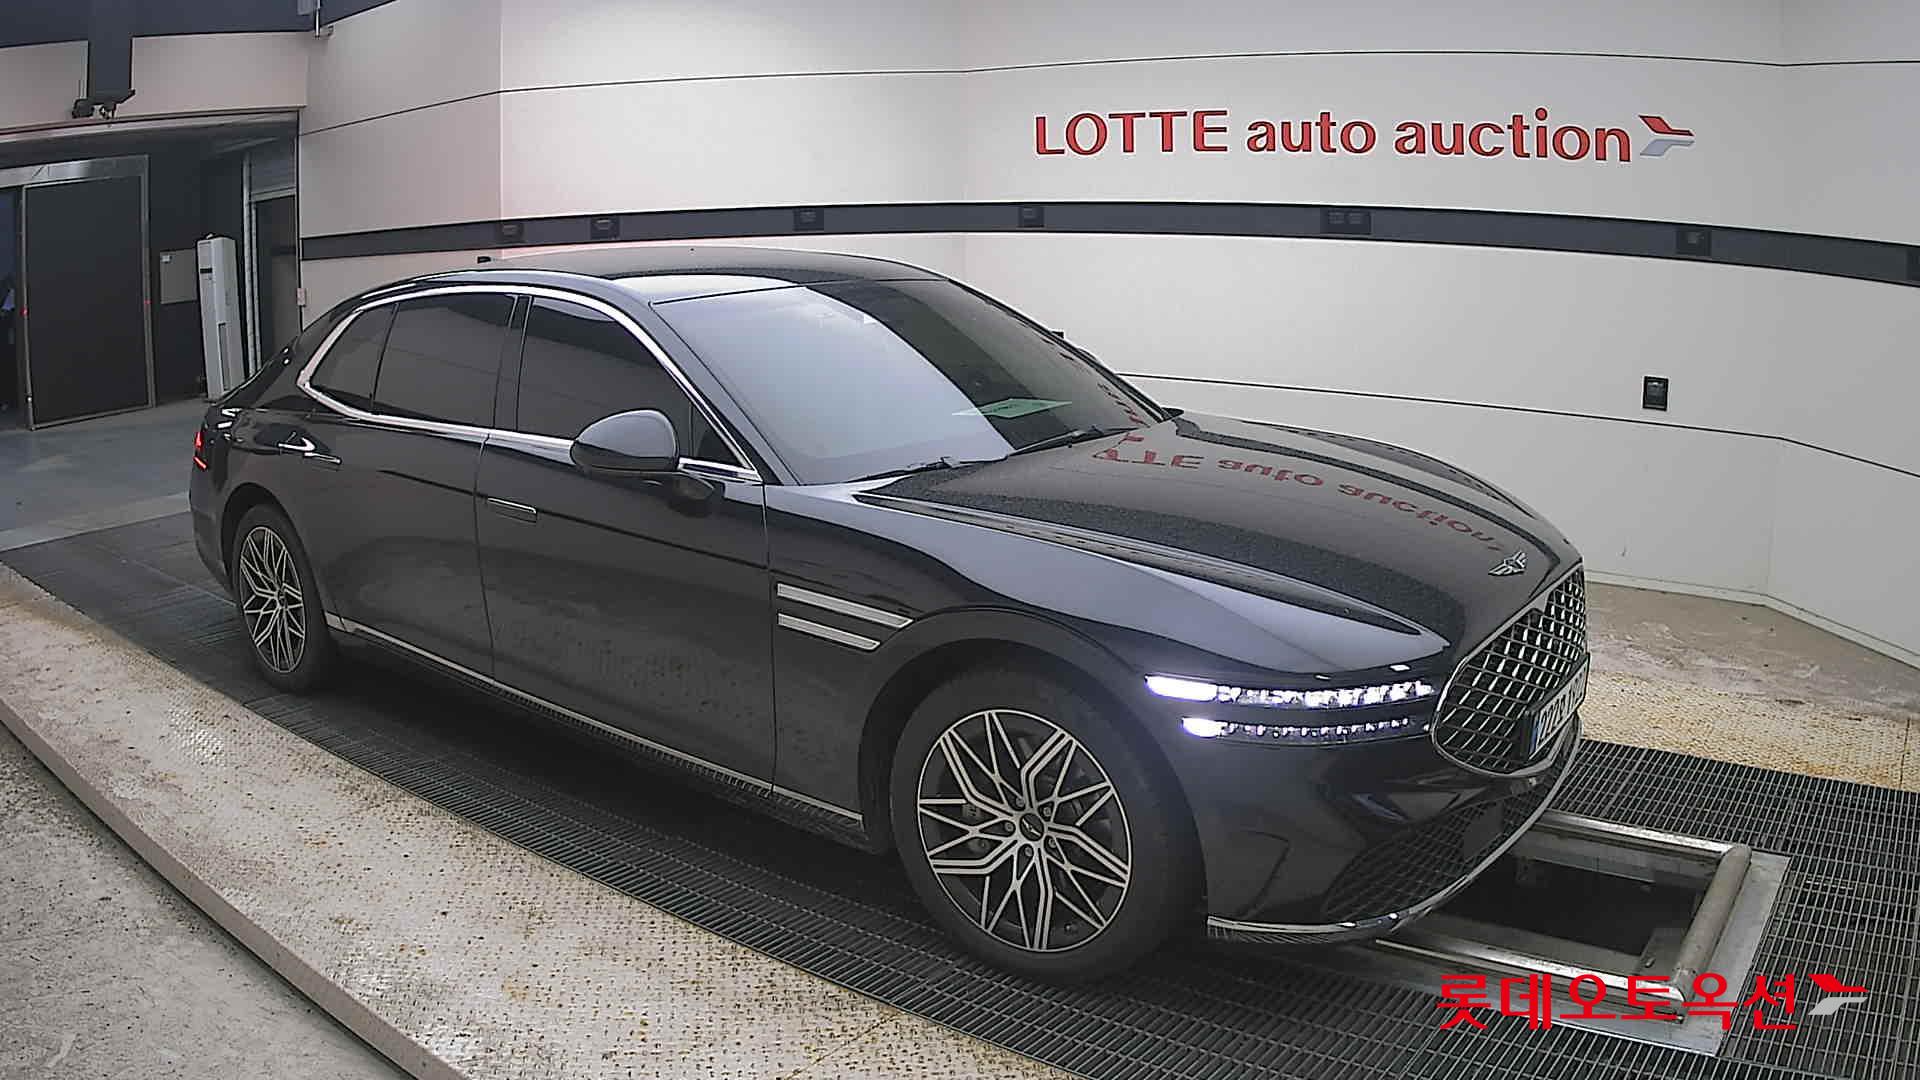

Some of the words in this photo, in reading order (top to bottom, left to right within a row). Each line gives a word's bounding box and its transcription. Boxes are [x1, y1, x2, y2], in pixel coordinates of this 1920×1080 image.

[1034, 108, 1229, 156] LOTTE
[1245, 110, 1377, 156] auto
[1393, 106, 1633, 163] auction
